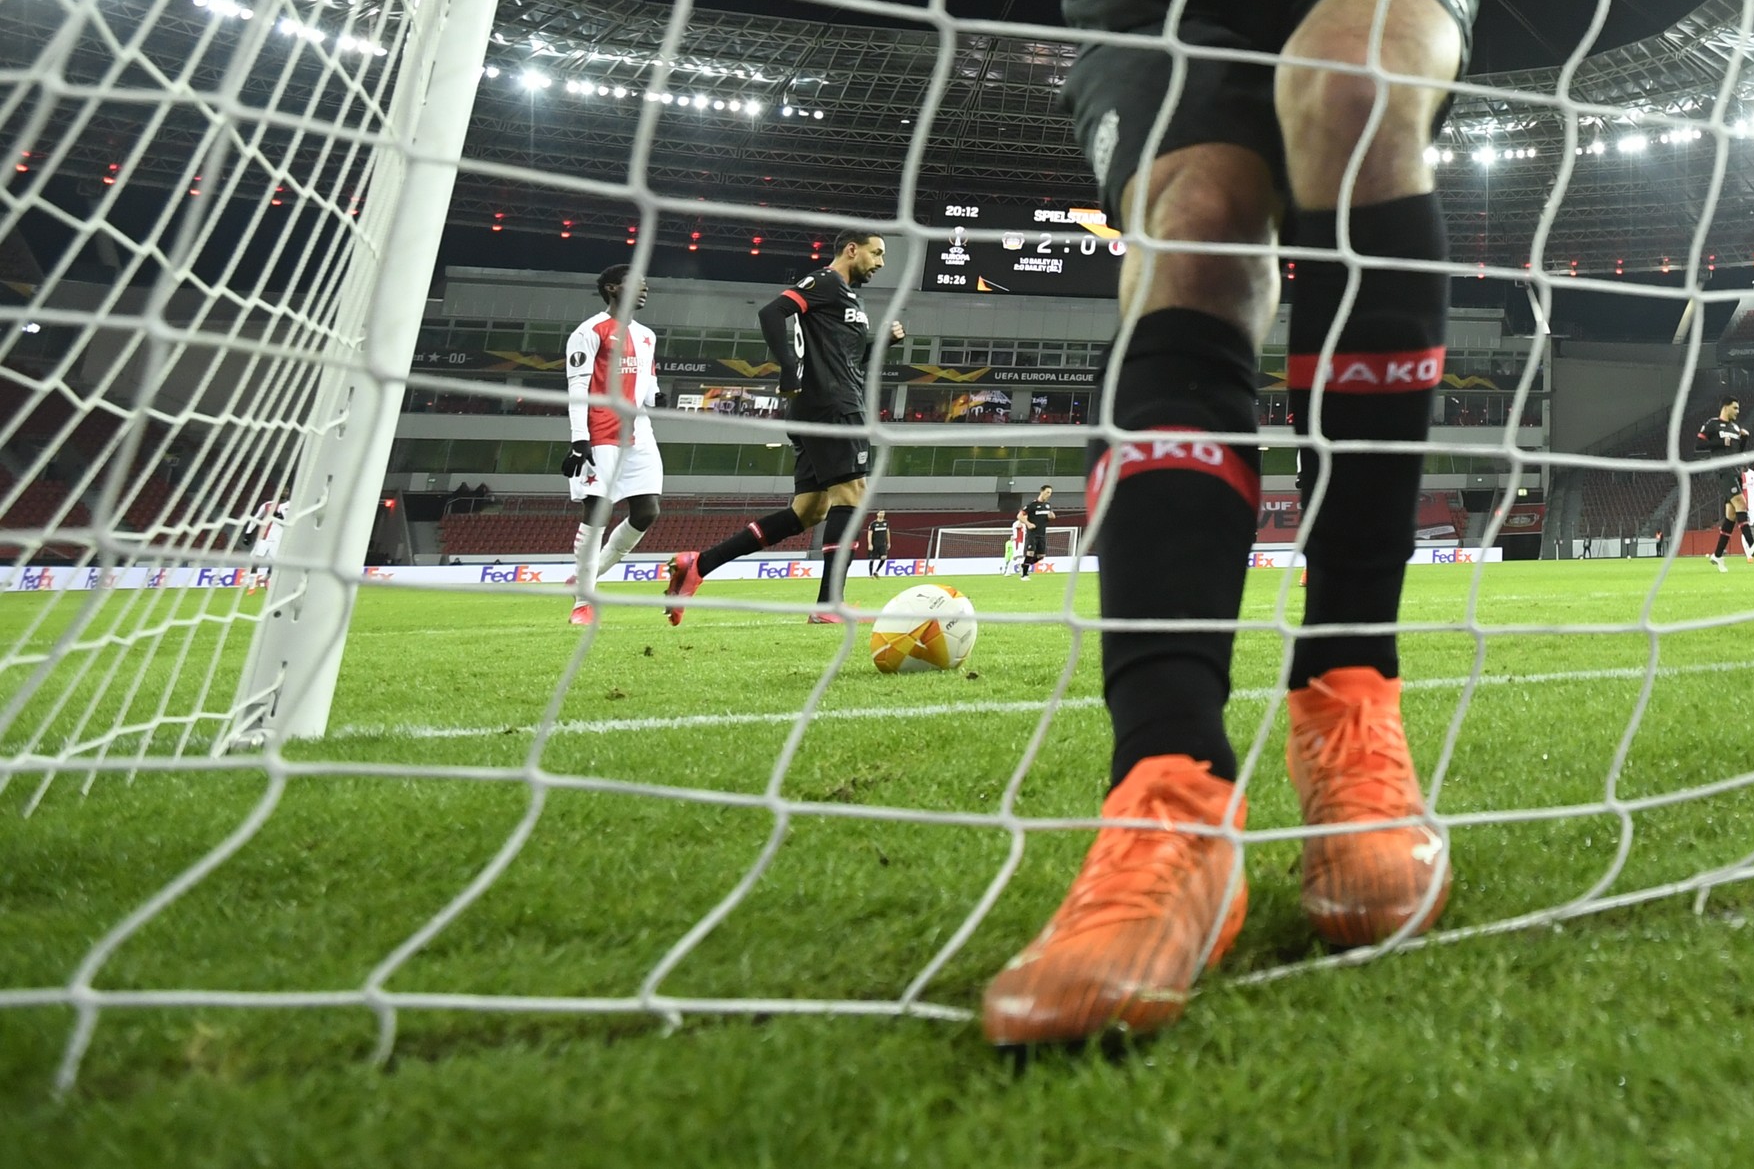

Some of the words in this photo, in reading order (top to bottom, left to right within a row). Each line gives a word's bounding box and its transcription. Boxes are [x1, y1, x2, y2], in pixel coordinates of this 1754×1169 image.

[945, 205, 979, 218] 20:12
[1033, 209, 1107, 226] SPIELSTAND
[941, 252, 970, 261] EUROPA
[1029, 258, 1051, 266] BAILEY
[1025, 264, 1047, 272] BAILEY
[937, 274, 967, 285] 58:26
[663, 363, 706, 372] LEAGUE
[995, 372, 1020, 380] UEFA
[1020, 373, 1057, 381] EUROPA
[1058, 374, 1094, 382] LEAGUE
[1432, 549, 1472, 564] FedEx
[623, 564, 671, 581] FedE
[758, 562, 812, 578] FedEx
[885, 559, 935, 576] FedEx
[480, 566, 542, 583] FedEx
